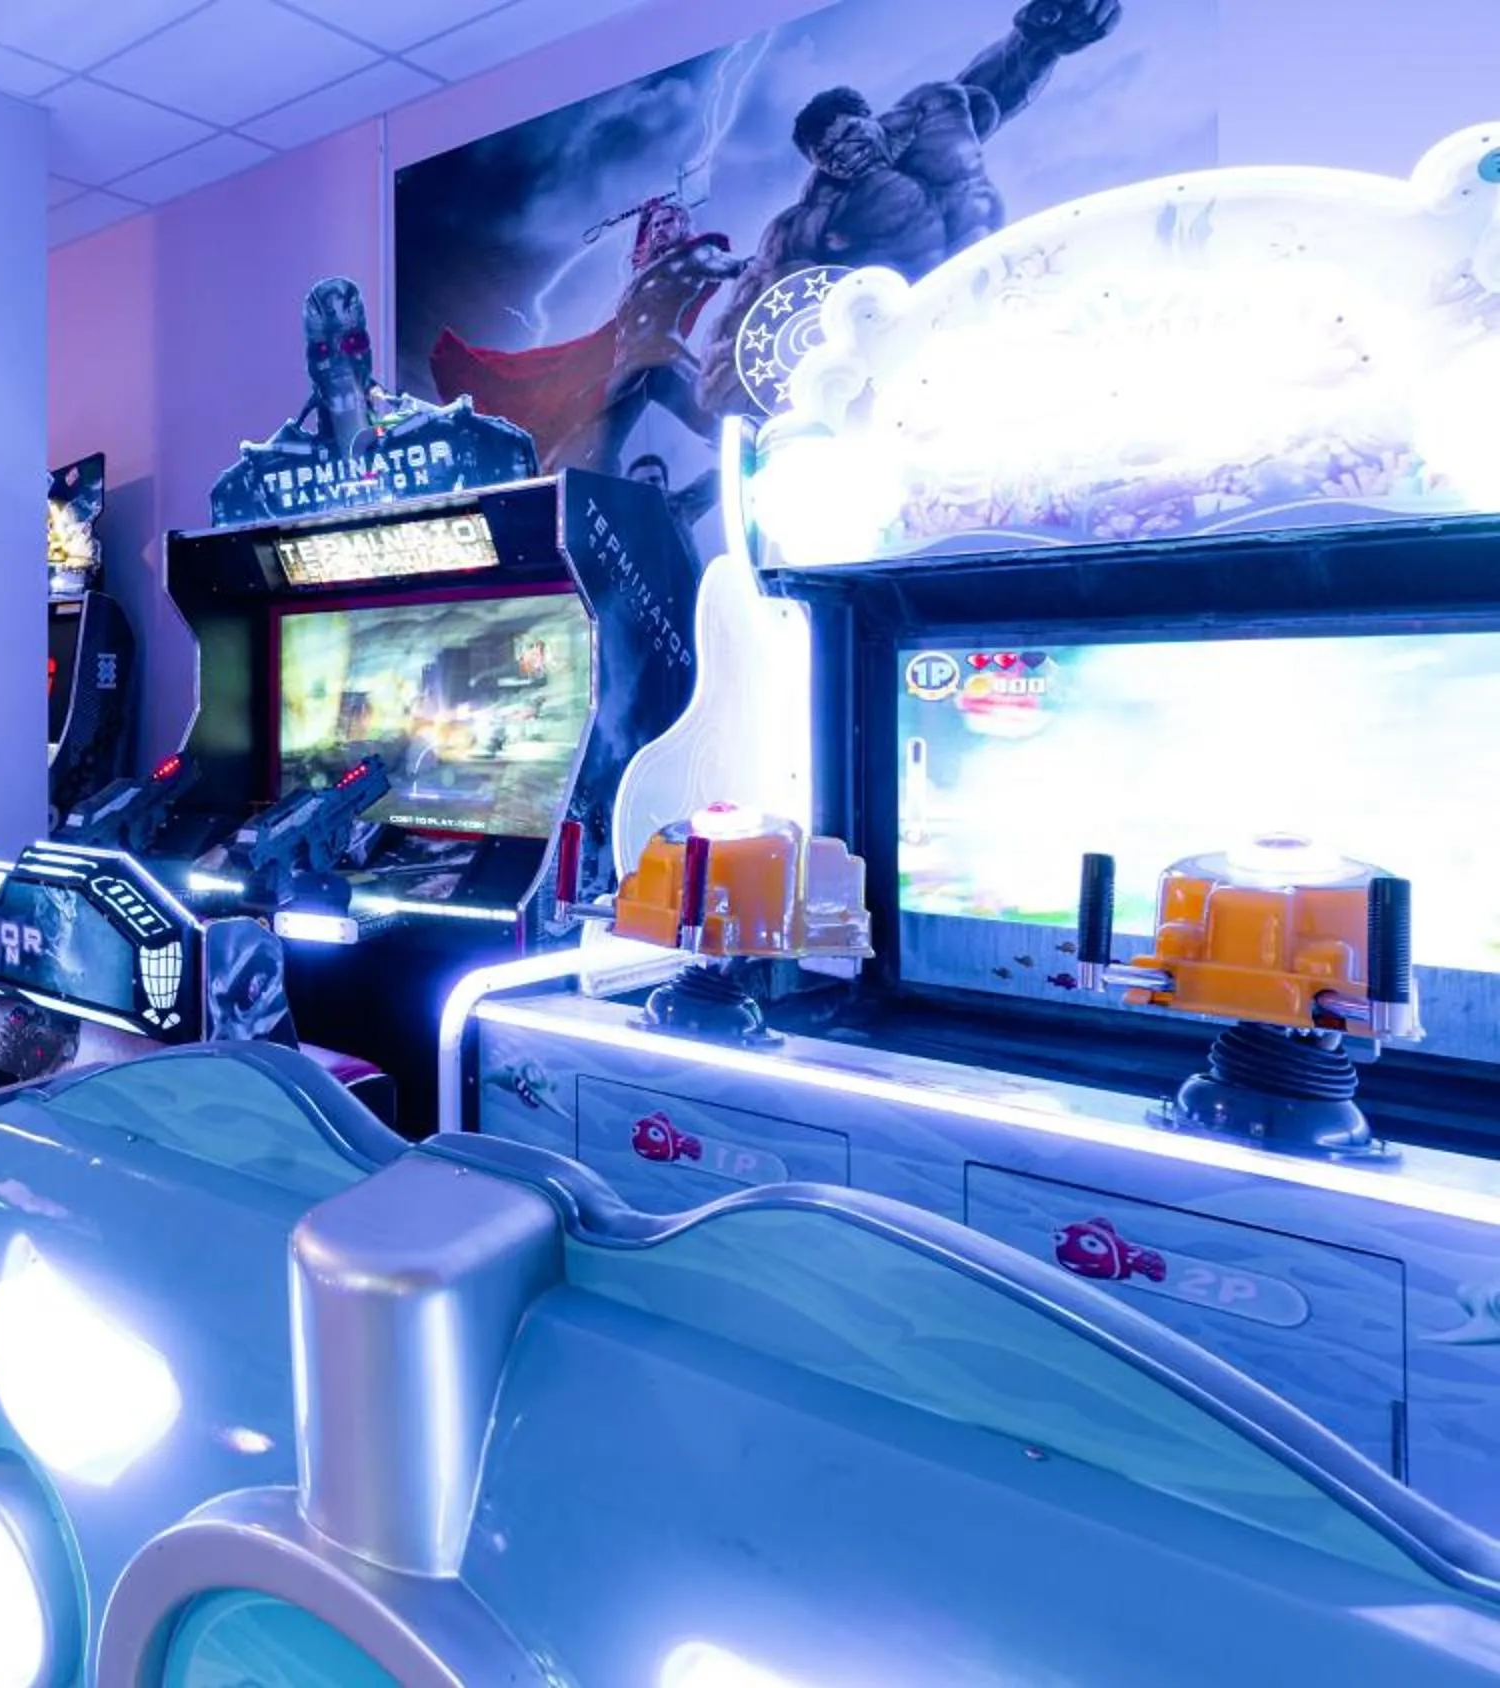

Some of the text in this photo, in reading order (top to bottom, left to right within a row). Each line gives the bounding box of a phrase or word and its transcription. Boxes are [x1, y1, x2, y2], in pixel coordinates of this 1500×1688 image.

[263, 441, 454, 493] TERMINATOR
[283, 469, 430, 508] SALVATION
[914, 662, 953, 687] 1P
[715, 1147, 757, 1174] 1P
[1178, 1267, 1257, 1305] 2P
